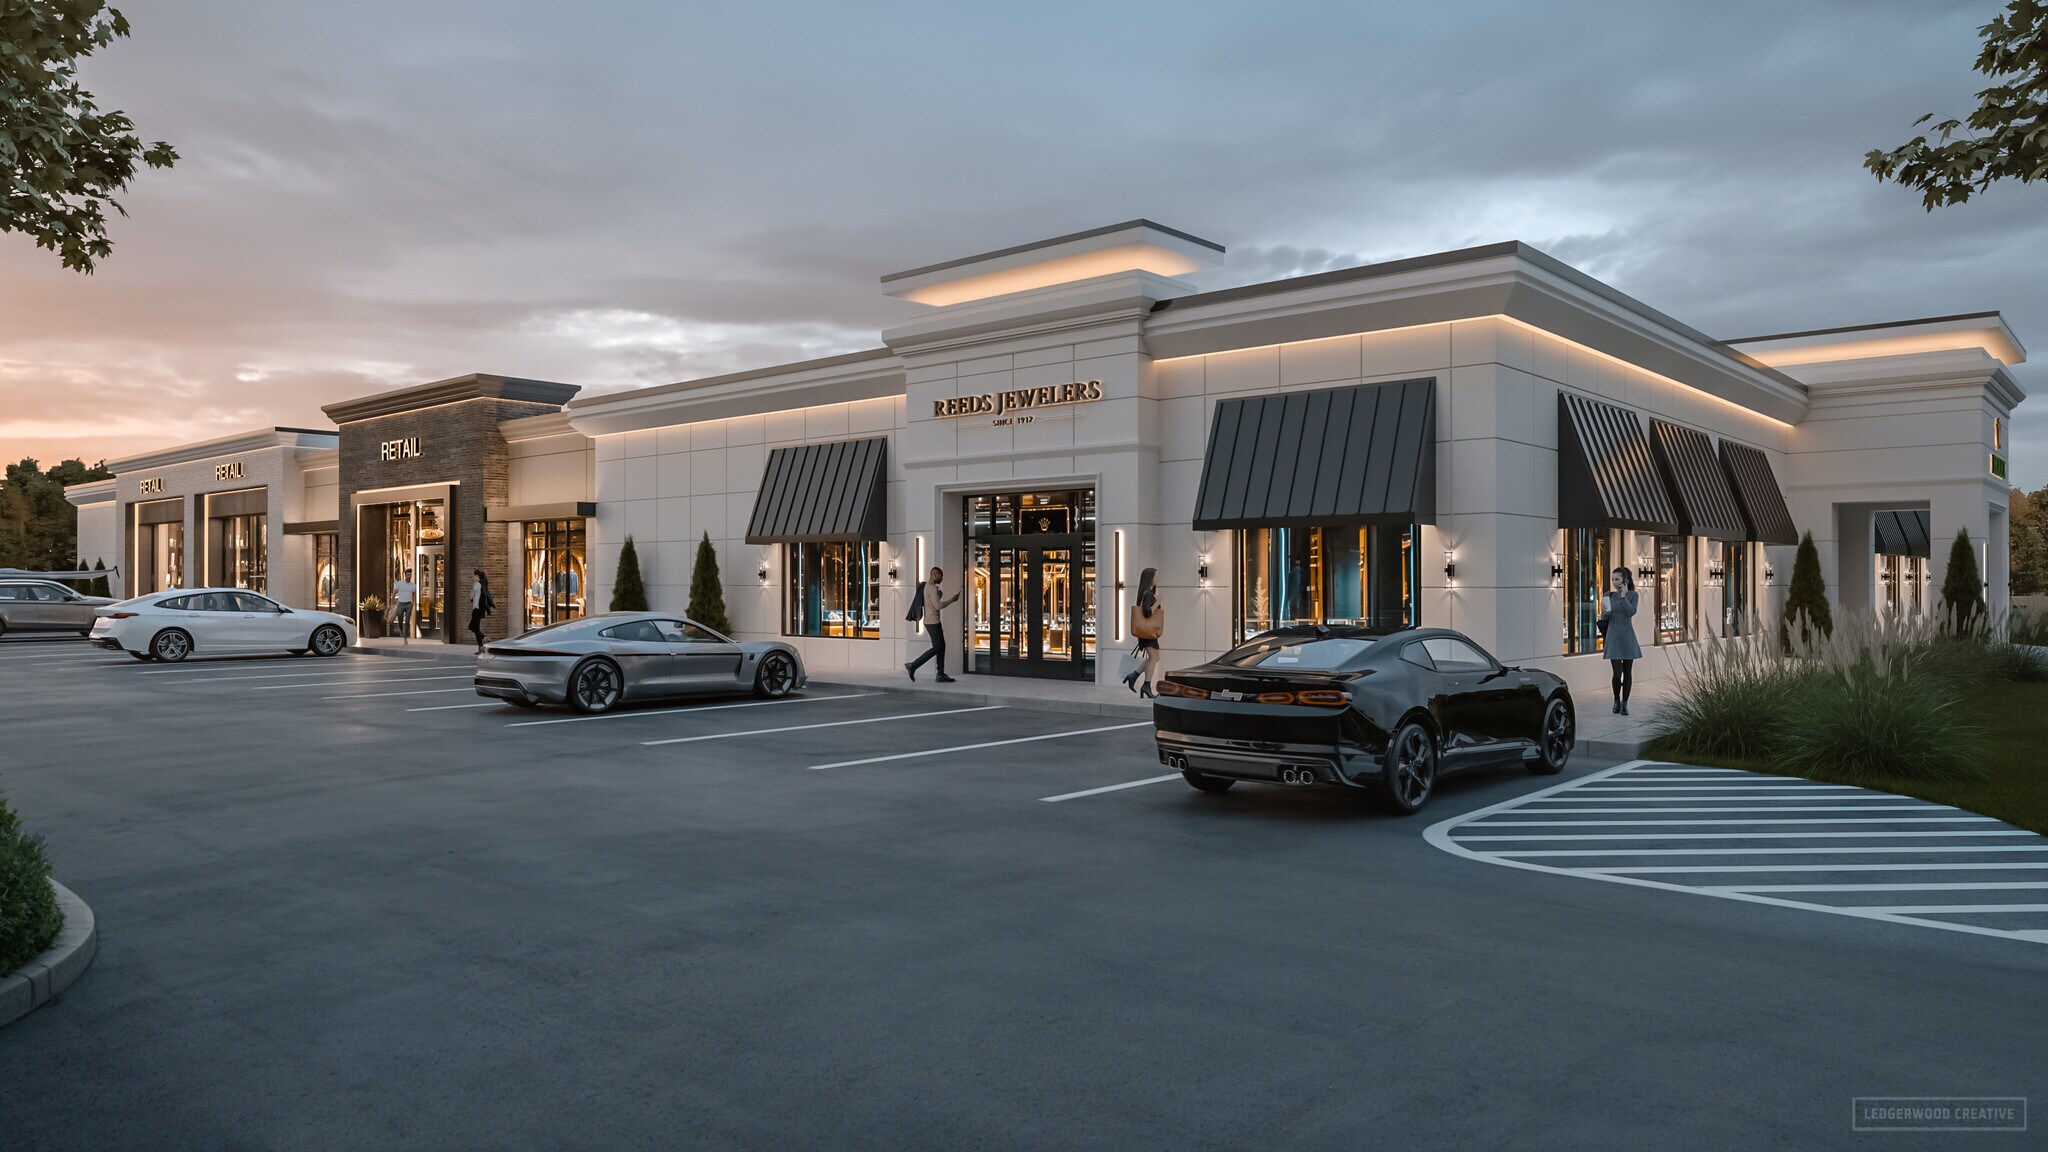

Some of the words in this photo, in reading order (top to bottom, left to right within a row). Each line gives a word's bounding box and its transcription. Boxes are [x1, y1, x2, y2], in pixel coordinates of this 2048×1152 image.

[933, 394, 993, 417] REEDS
[995, 380, 1101, 415] JEWELERS
[992, 417, 1015, 427] SINCE
[1017, 416, 1034, 425] 1912
[381, 437, 422, 461] RETAIL
[215, 463, 243, 481] RETAIL
[140, 479, 163, 494] RETAIL
